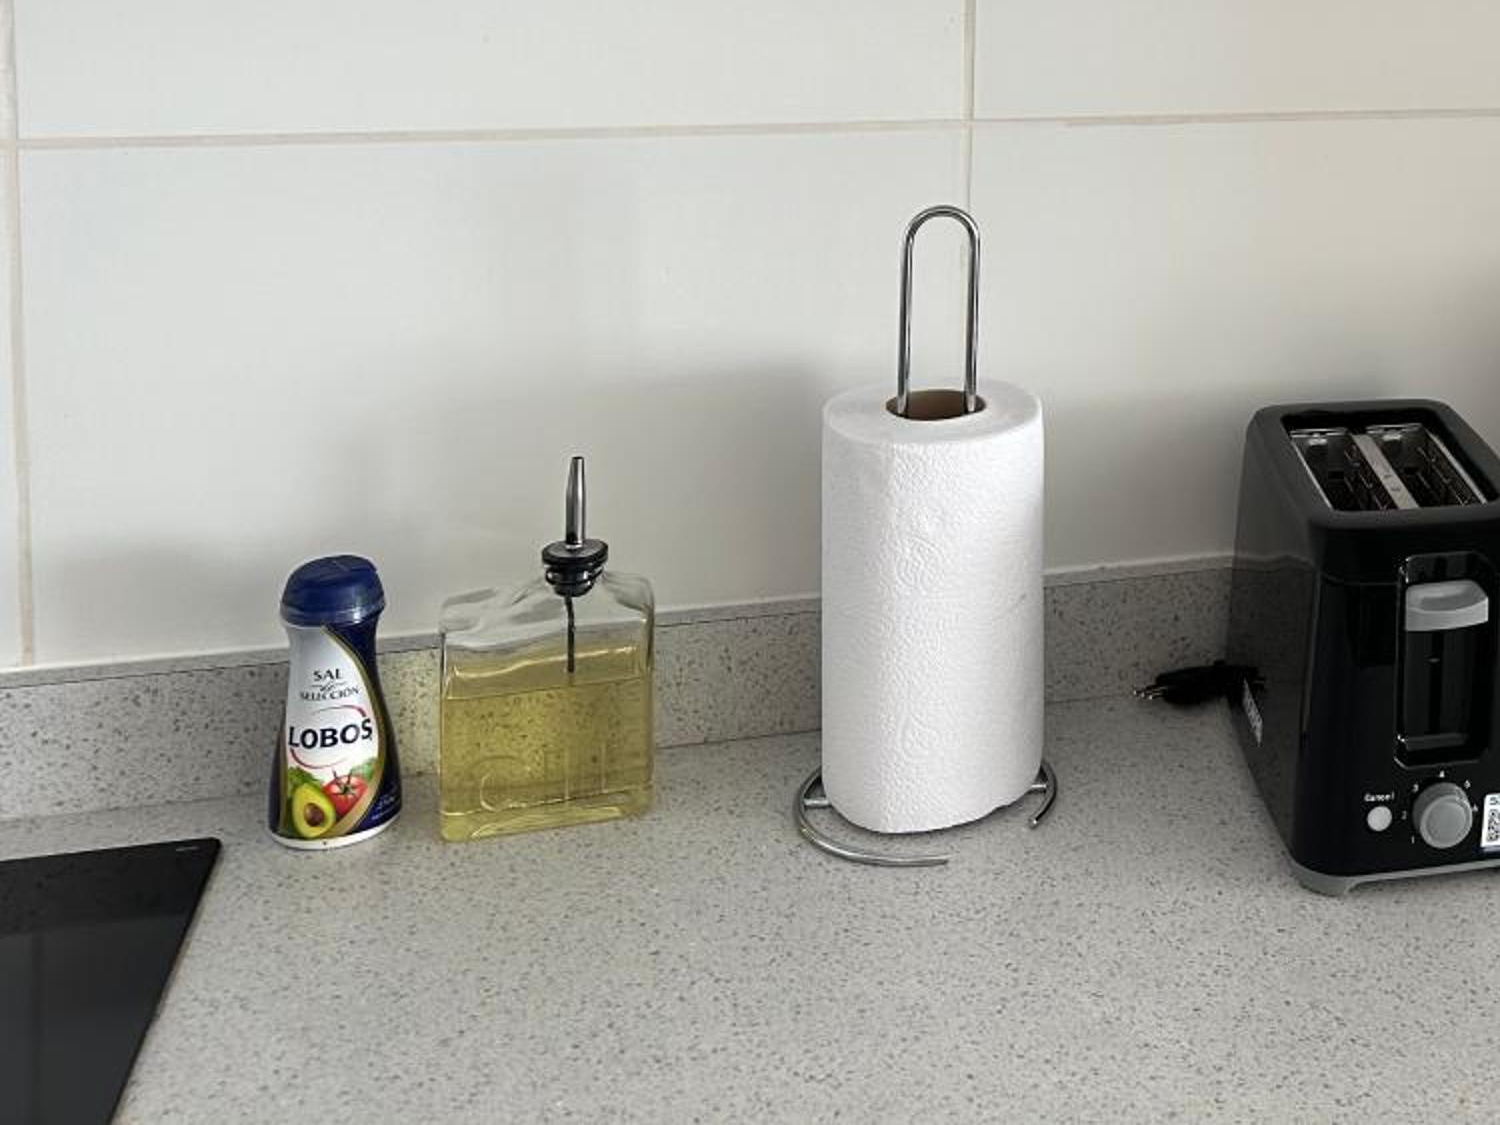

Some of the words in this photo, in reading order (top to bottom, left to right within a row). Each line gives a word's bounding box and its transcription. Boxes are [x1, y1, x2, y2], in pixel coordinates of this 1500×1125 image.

[312, 668, 343, 682] SAL
[288, 717, 372, 751] LOBOS
[1364, 791, 1396, 803] Cancel
